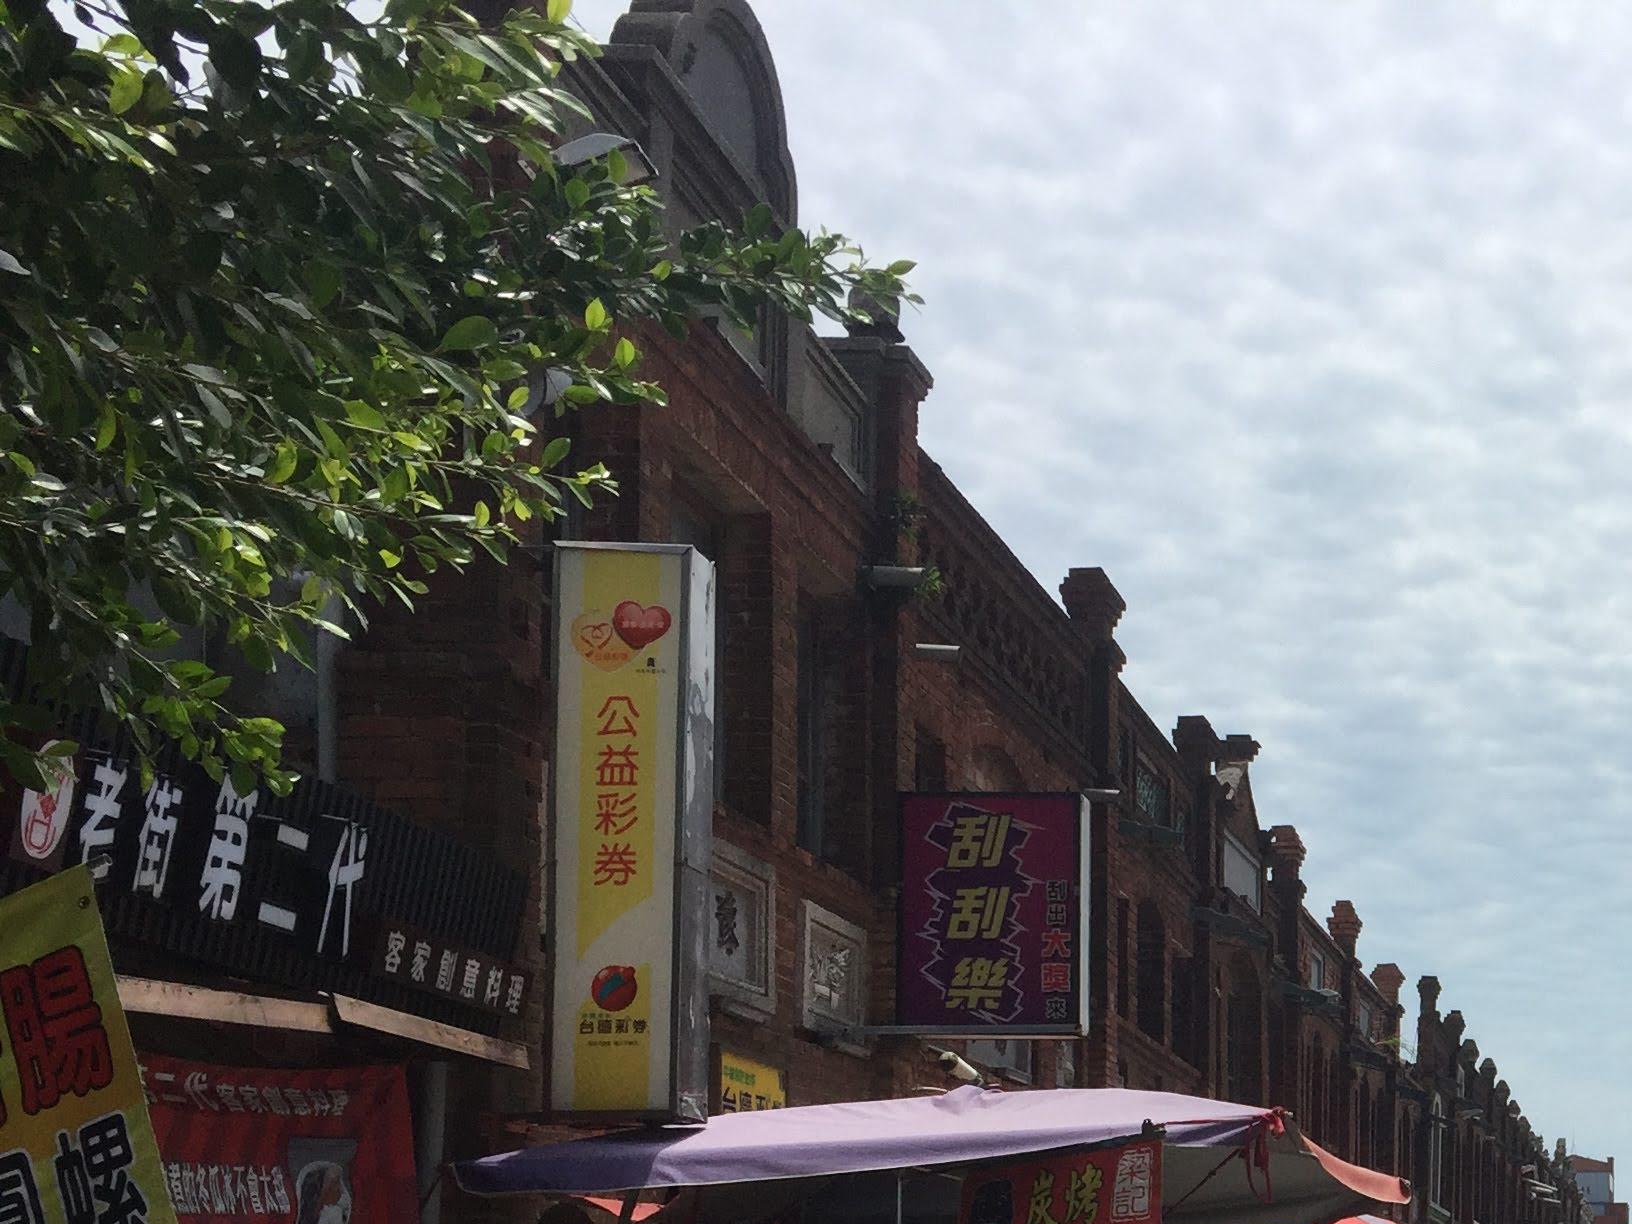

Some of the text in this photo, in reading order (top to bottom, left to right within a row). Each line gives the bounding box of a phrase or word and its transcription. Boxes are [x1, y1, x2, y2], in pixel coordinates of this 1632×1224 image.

[79, 757, 368, 958] 老街第二代
[593, 694, 640, 887] 公益彩券
[384, 930, 525, 1015] 客家創意料理
[945, 813, 1009, 1011] 刮刮樂
[1041, 879, 1072, 1019] 刮出大獎來
[138, 1063, 350, 1119] 二代客家創意料理
